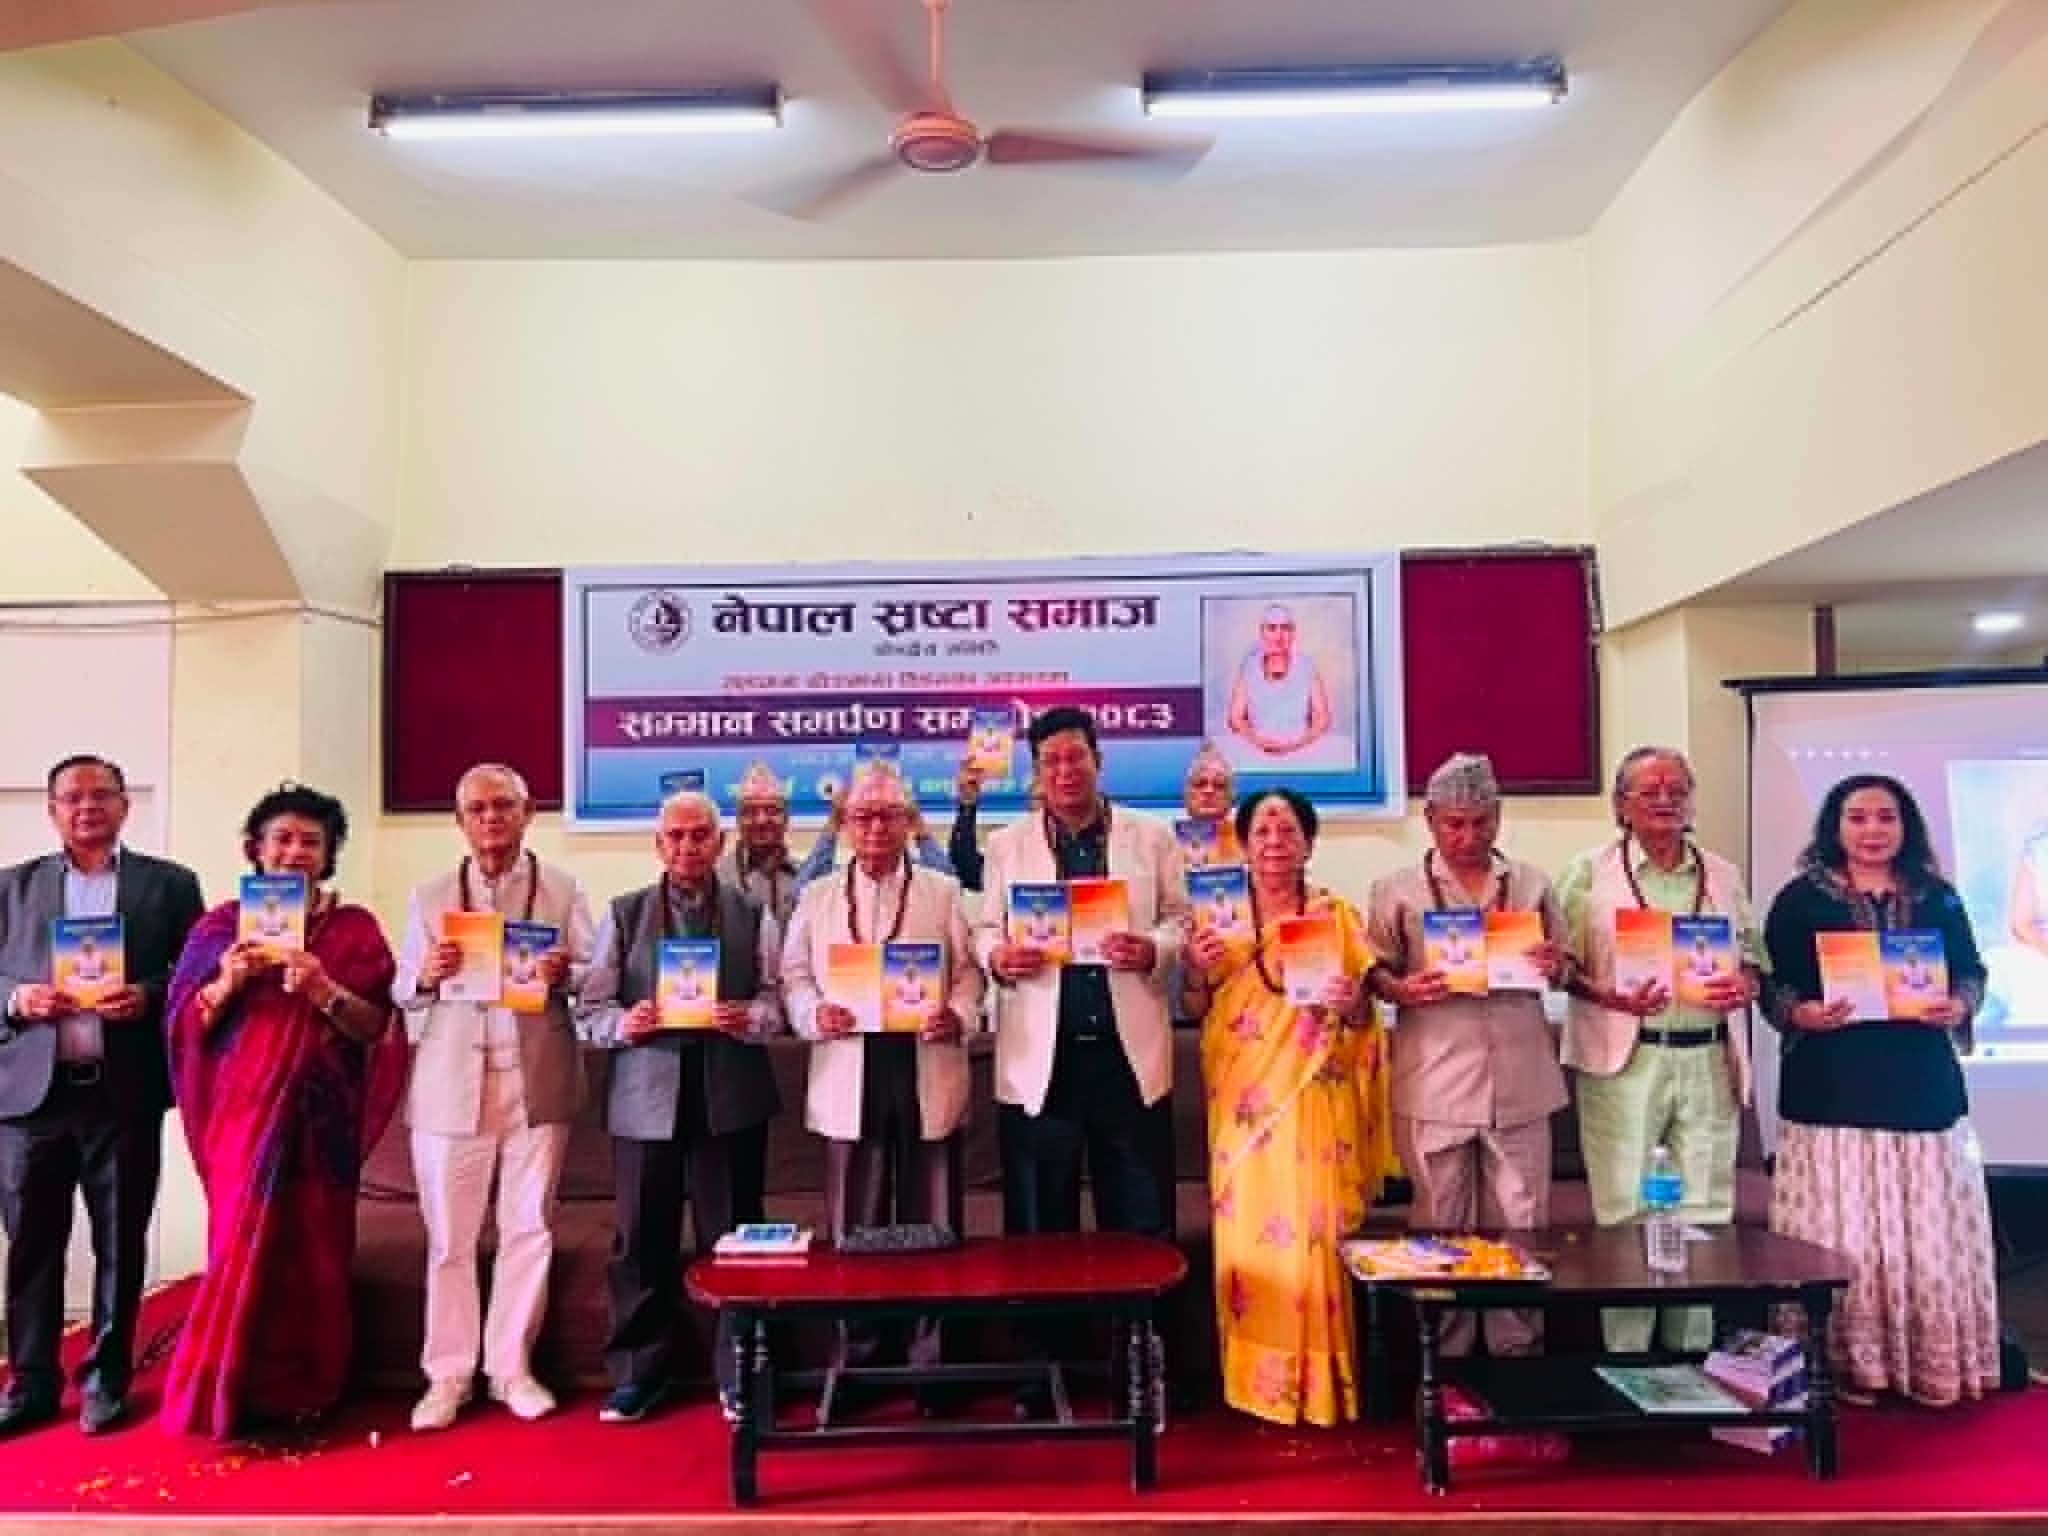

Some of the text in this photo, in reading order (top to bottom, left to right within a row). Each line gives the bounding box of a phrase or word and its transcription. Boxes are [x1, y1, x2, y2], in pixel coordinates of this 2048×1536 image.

[711, 593, 857, 636] नेपाल
[1007, 595, 1161, 632] समाज
[618, 708, 758, 741] सम्मान
[767, 702, 904, 738] समर्पण
